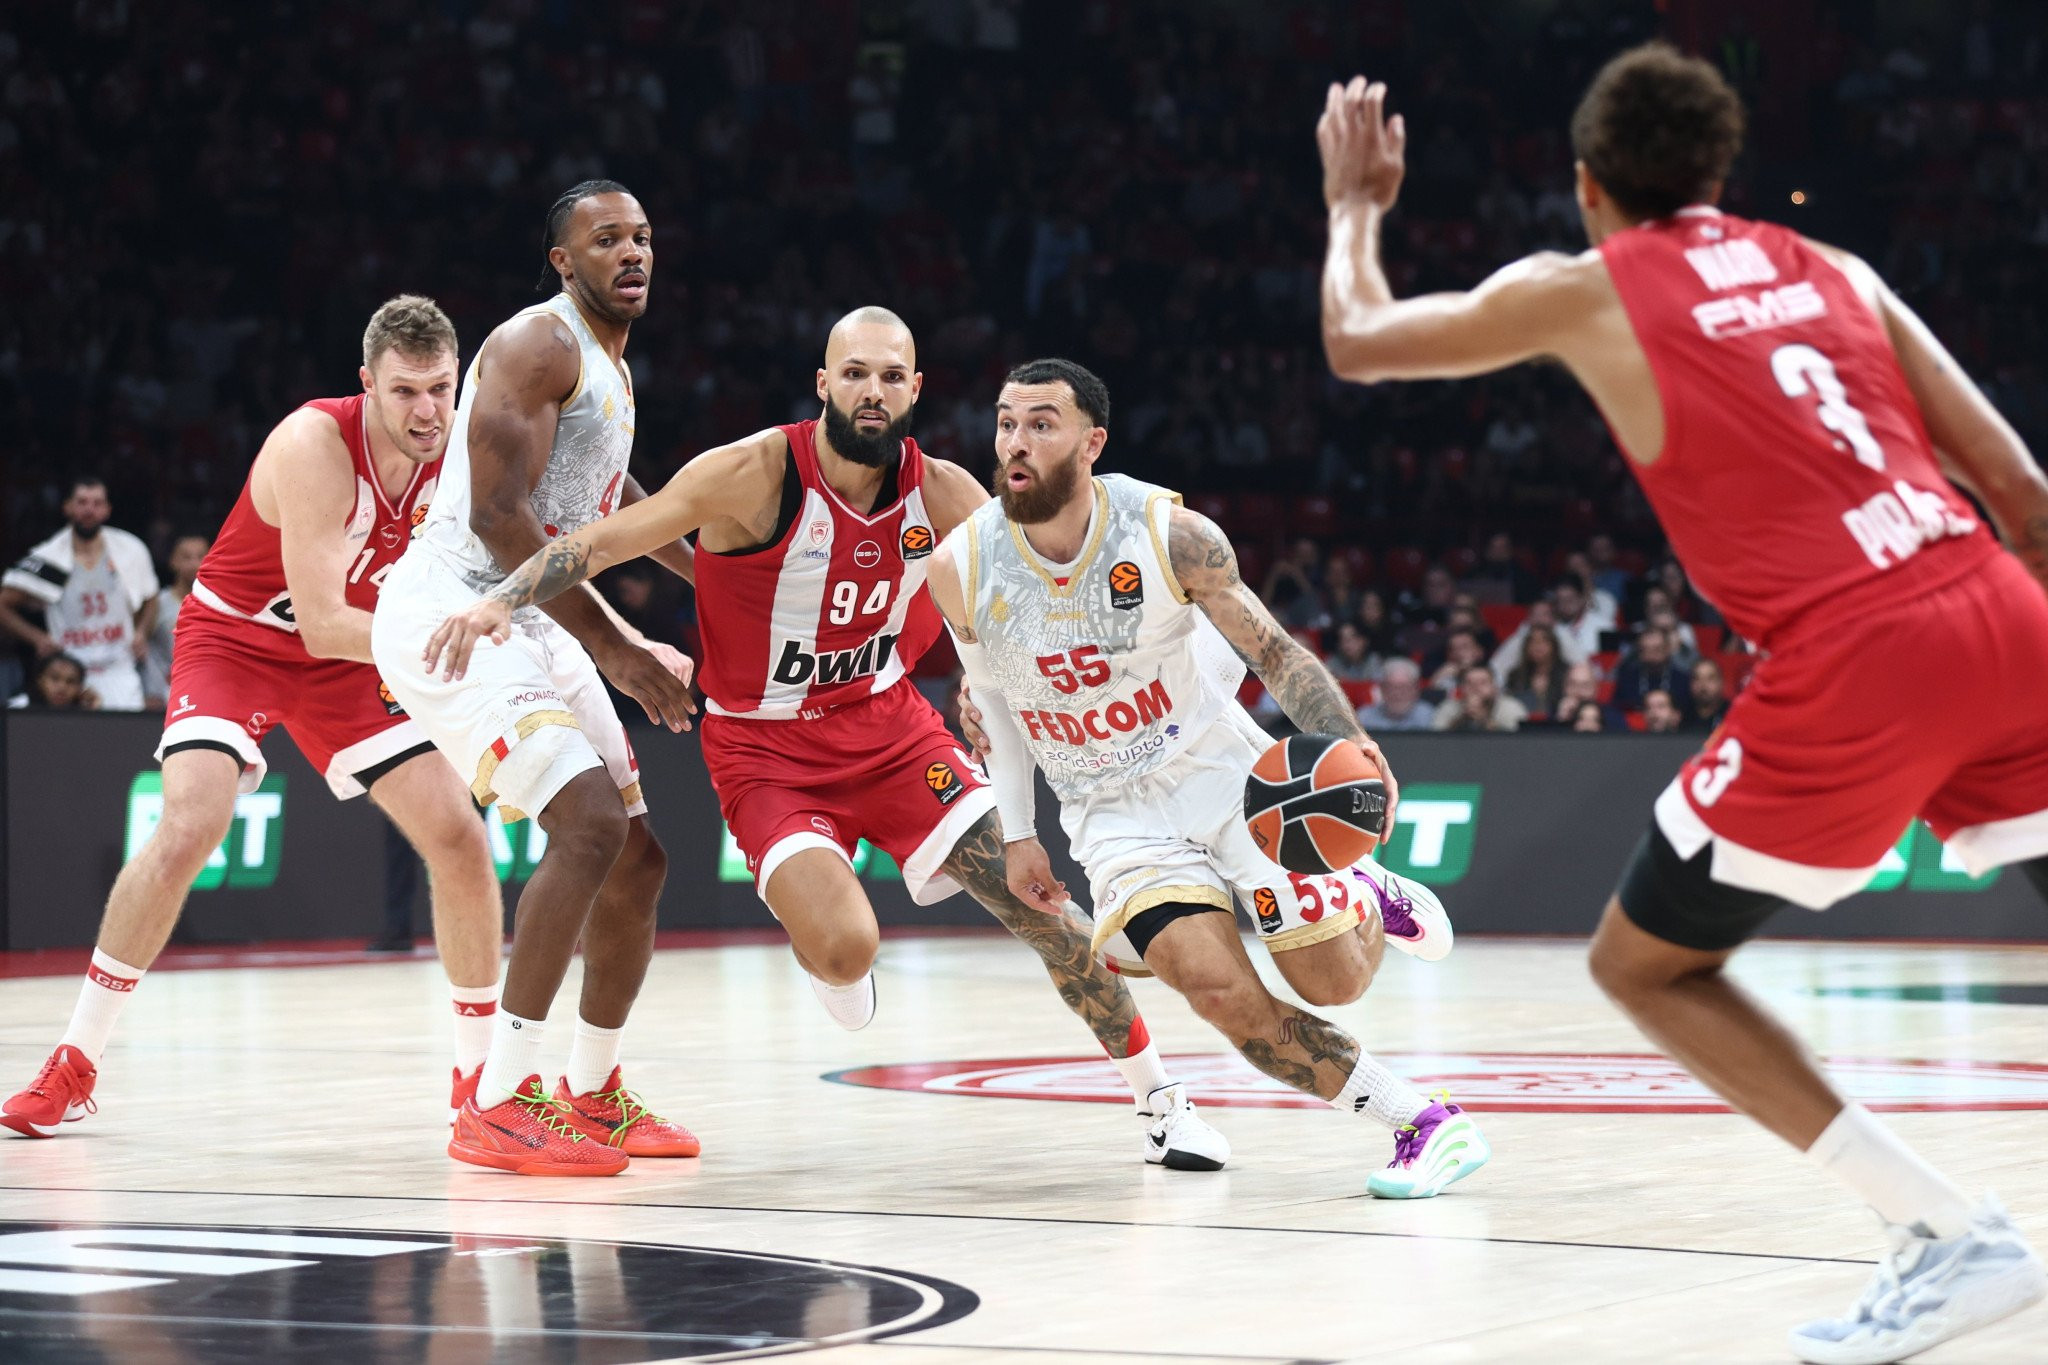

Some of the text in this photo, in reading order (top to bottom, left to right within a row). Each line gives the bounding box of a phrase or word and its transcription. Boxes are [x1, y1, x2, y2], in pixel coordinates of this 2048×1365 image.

[1770, 341, 1888, 475] 3
[856, 550, 879, 558] GSA
[829, 580, 891, 625] 94
[1036, 644, 1111, 695] 55
[1019, 678, 1173, 747] FEDCOM
[1691, 737, 1742, 808] 3
[95, 972, 136, 991] GSA
